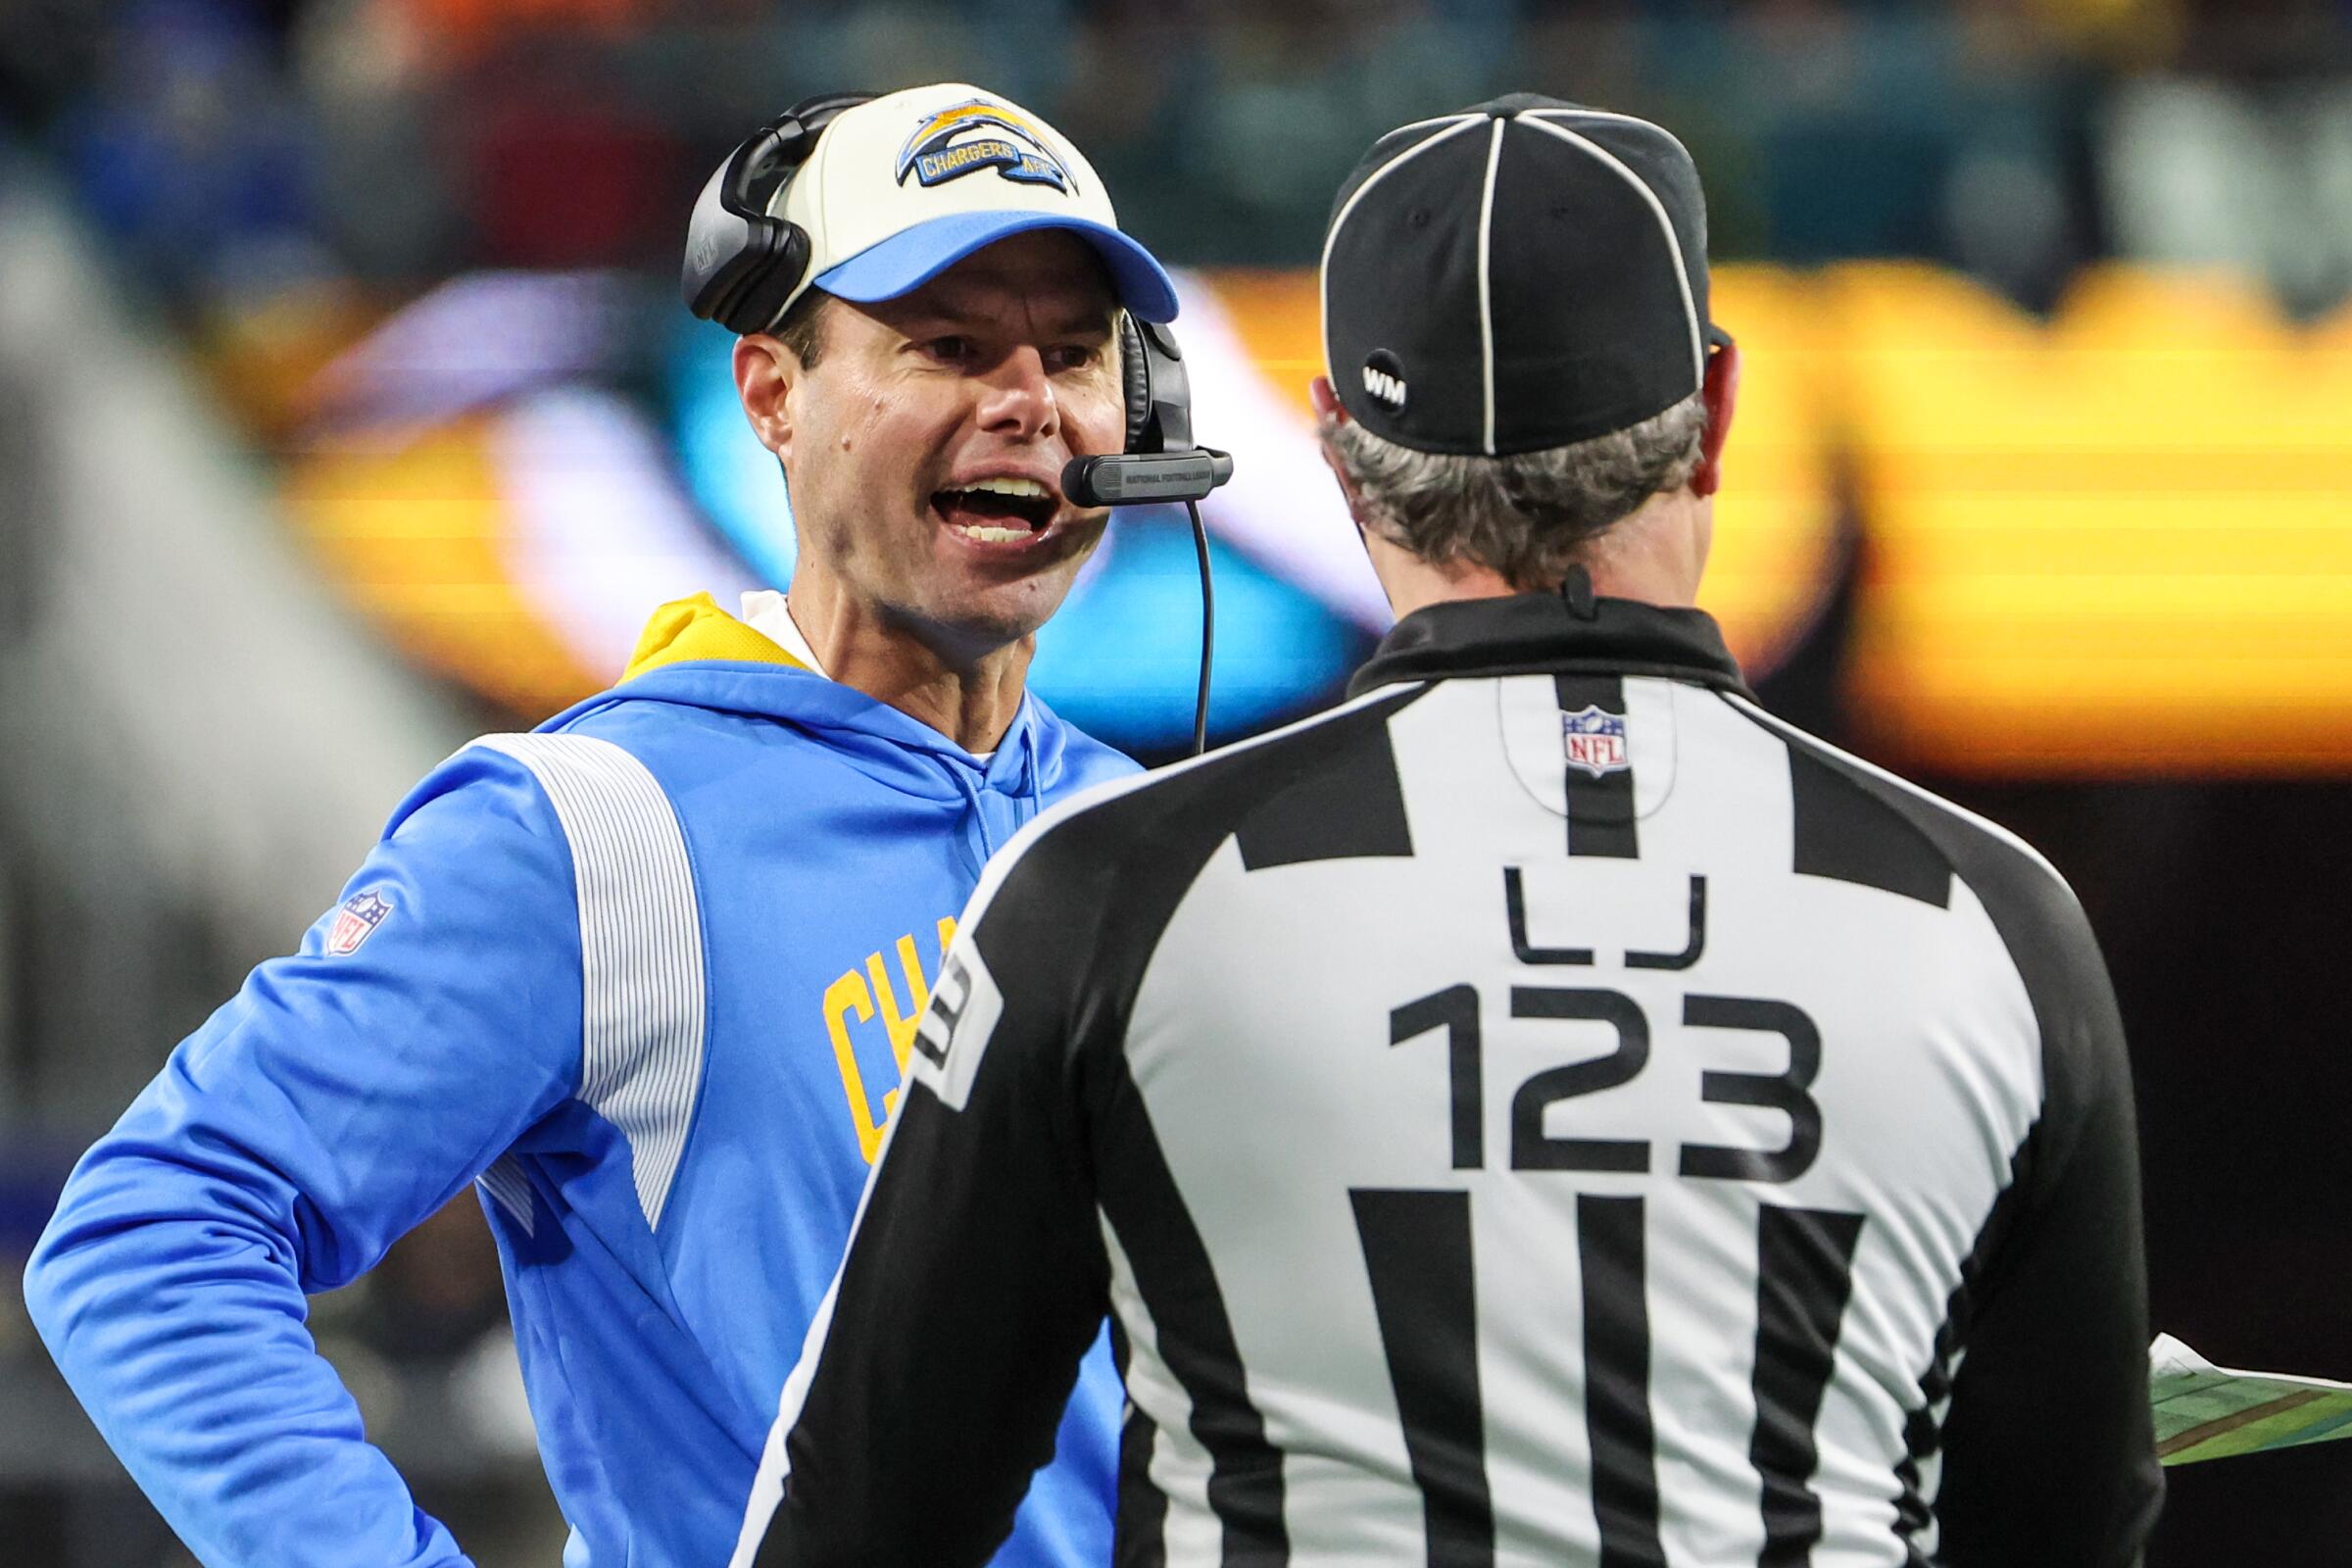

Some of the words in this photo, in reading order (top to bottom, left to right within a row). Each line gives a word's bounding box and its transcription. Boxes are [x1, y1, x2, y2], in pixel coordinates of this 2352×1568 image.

[921, 142, 1013, 177] CHARGERS
[1362, 366, 1406, 407] WM
[1570, 735, 1624, 764] NFL
[331, 912, 367, 950] NFL
[1502, 866, 1707, 971] LJ
[1390, 982, 1822, 1184] 123
